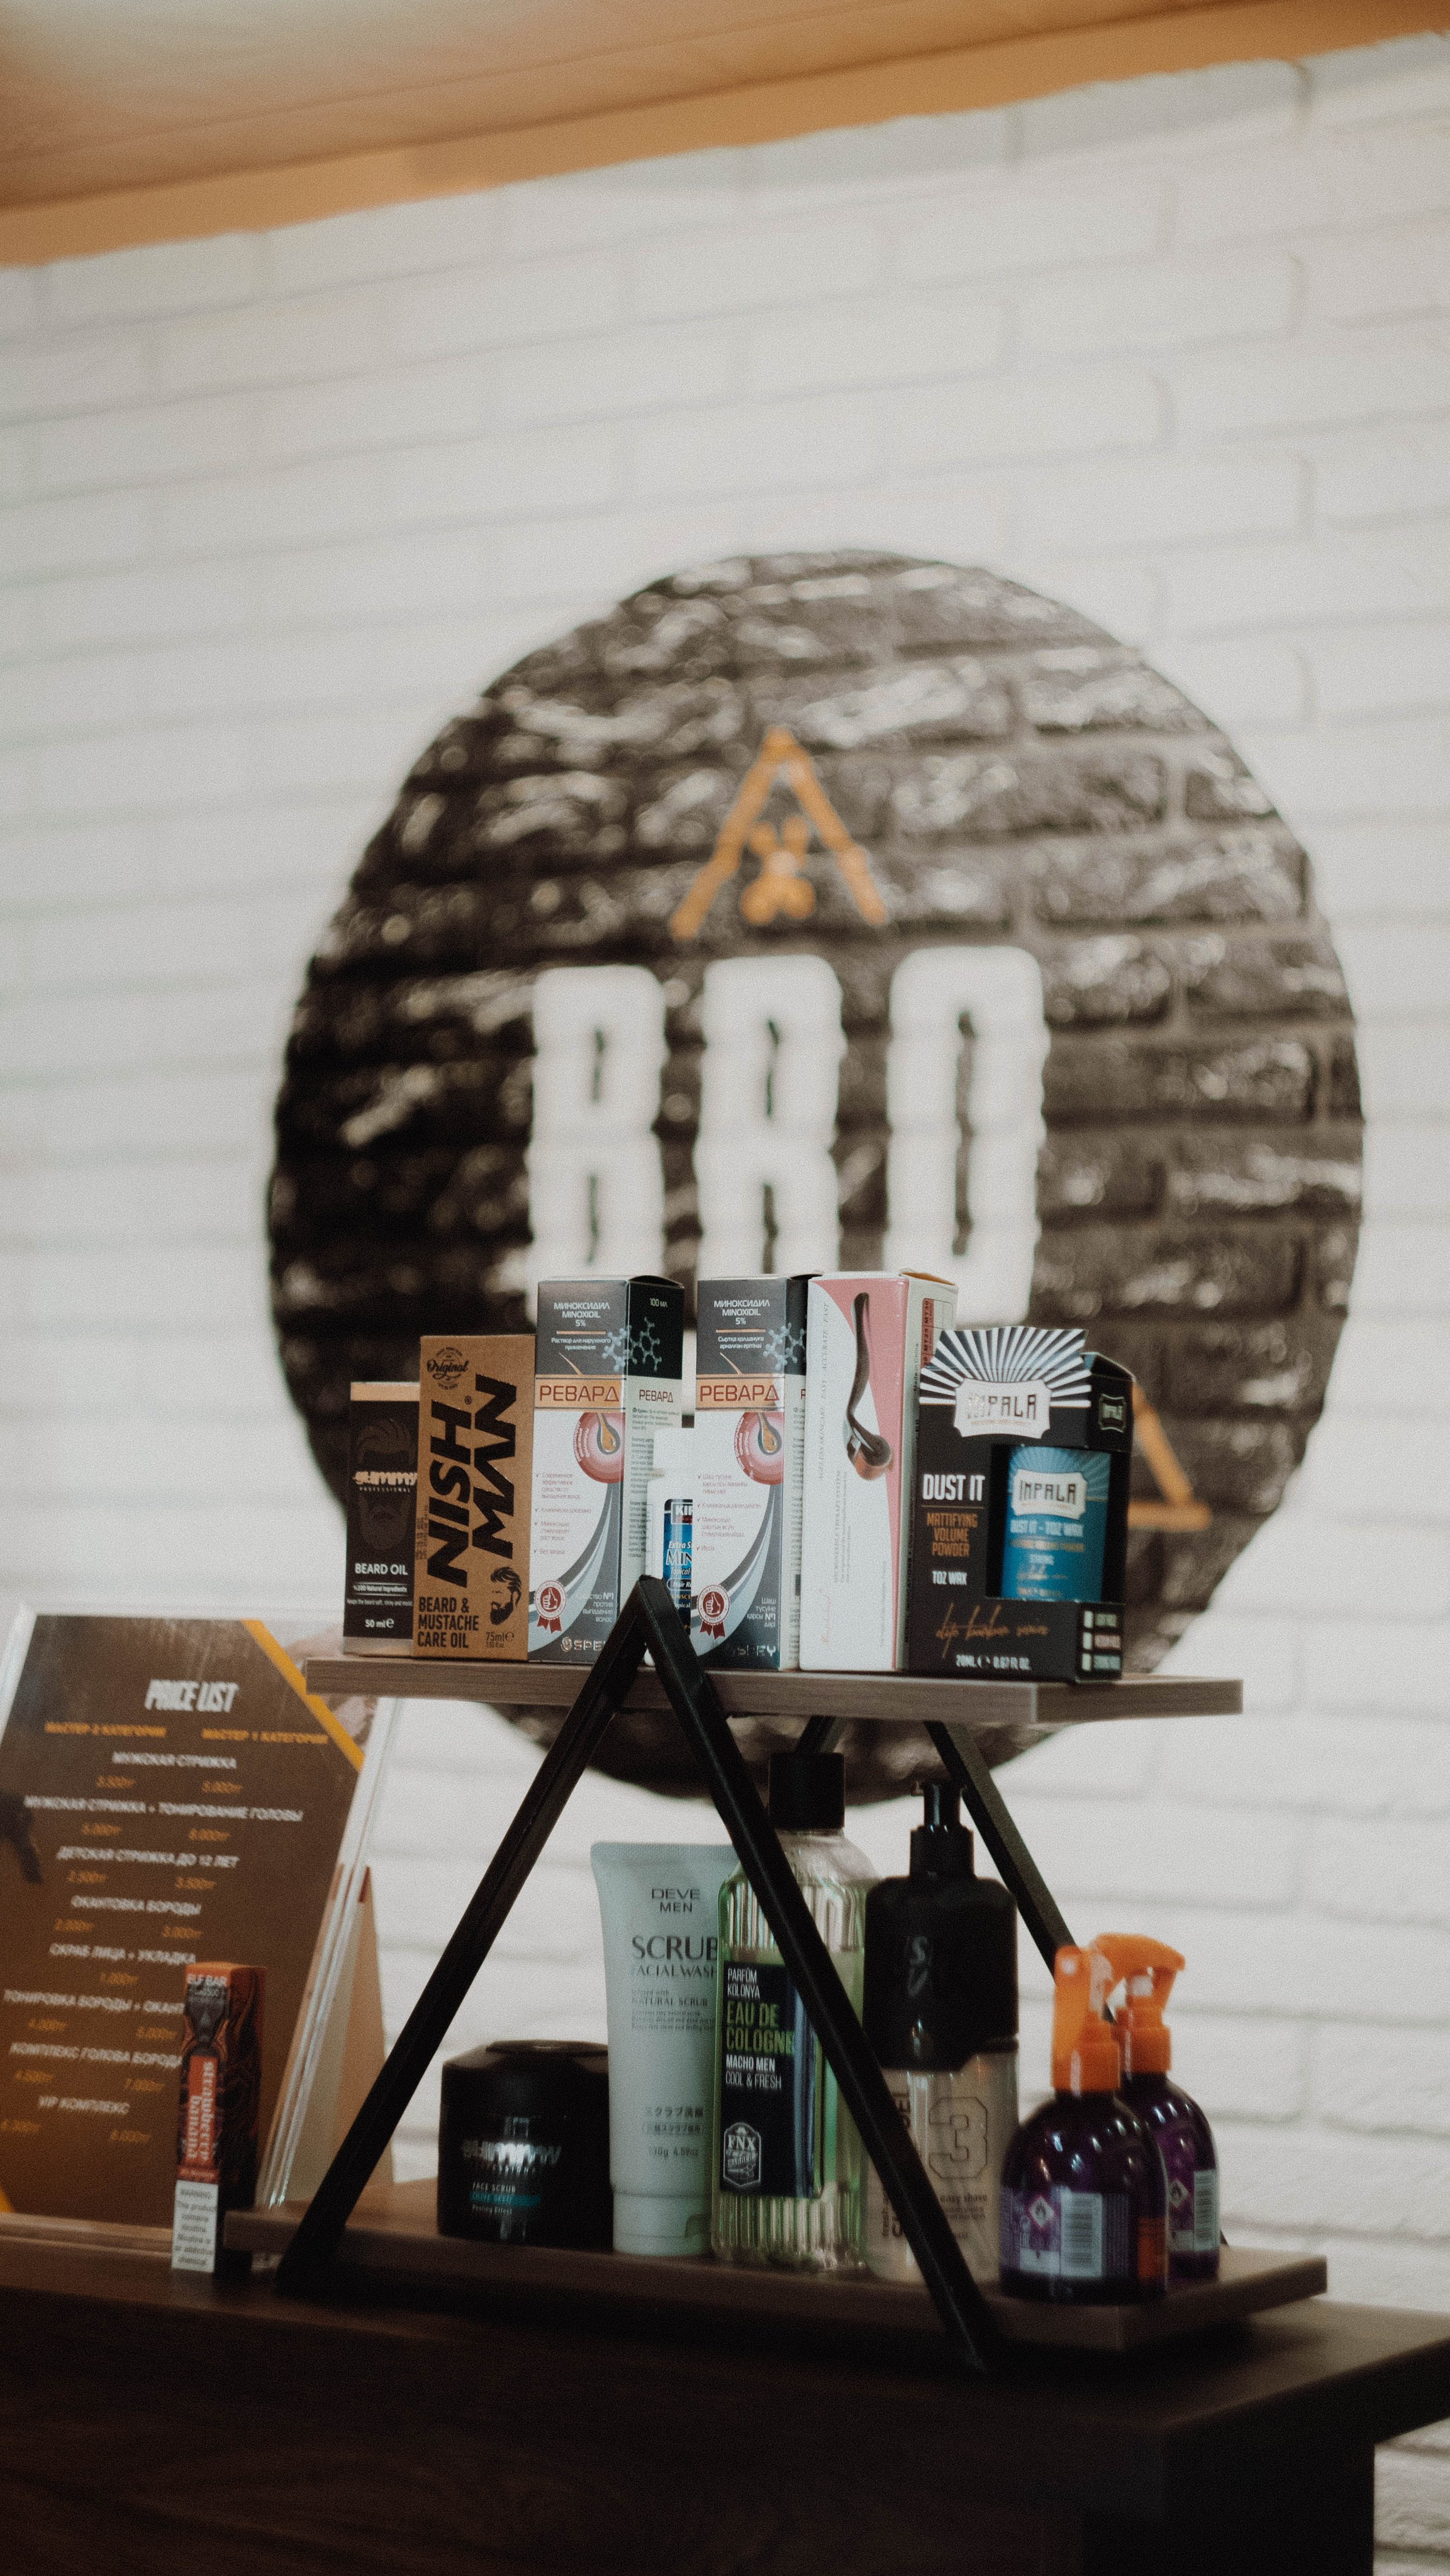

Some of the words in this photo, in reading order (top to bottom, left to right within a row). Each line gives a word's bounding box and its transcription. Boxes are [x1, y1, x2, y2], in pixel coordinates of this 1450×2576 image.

[525, 945, 1051, 1323] BRO
[650, 1298, 659, 1306] 100
[714, 1299, 771, 1307] МИНОКСИДИЛ
[562, 1311, 601, 1319] MINOXIDIL
[427, 1359, 469, 1380] Original
[540, 1385, 620, 1402] РЕВАРД
[639, 1389, 674, 1402] РЕВАРД
[700, 1385, 779, 1402] РЕВАРД
[472, 1373, 518, 1560] MAN
[427, 1399, 472, 1589] NISH
[923, 1474, 966, 1501] DUST
[969, 1475, 985, 1501] IT
[1018, 1480, 1076, 1505] IMPALA
[927, 1513, 978, 1528] MATTIFYING
[934, 1528, 969, 1543] VOLUME
[669, 1541, 686, 1549] Extra
[932, 1542, 970, 1558] POWDER
[354, 1562, 388, 1575] BEARD
[390, 1563, 408, 1576] OIL
[671, 1567, 690, 1575] Topical
[419, 1596, 457, 1613] BEARD
[461, 1597, 470, 1613] &
[365, 1619, 375, 1628] 50
[376, 1619, 385, 1628] ml
[418, 1614, 479, 1632] MUSTACHE
[417, 1631, 446, 1648] CARE
[450, 1633, 469, 1649] OIL
[574, 1639, 605, 1651] SPE
[145, 1679, 198, 1711] PRICE
[199, 1682, 240, 1713] LIST
[112, 1752, 176, 1767] МУЖСКАЯ
[176, 1754, 237, 1770] СТРИЖКА
[25, 1796, 86, 1811] МУЖСКАЯ
[87, 1798, 147, 1813] СТРИЖКА
[159, 1801, 249, 1819] ТОНИРОВАНИЕ
[250, 1807, 304, 1823] ГОЛОВЫ
[55, 1845, 114, 1861] ДЕТСКАЯ
[115, 1848, 175, 1863] СТРИЖКА
[214, 1855, 240, 1869] ЛЕТ
[652, 1888, 701, 1901] DEVE
[70, 1895, 145, 1912] ОКАНТОВКА
[146, 1899, 202, 1917] БОРОДЫ
[659, 1902, 693, 1913] MEN
[632, 1935, 718, 1960] SCRUB
[137, 1949, 196, 1966] УКЛАДКА
[187, 1973, 204, 1985] ELF
[205, 1975, 227, 1987] BAR
[727, 1967, 757, 1983] PARFÜM
[4, 1989, 76, 2006] ТОНИРОВКА
[77, 1996, 132, 2011] БОРОДЫ
[727, 1984, 761, 1999] KOLONYA
[727, 2001, 755, 2026] EAU
[759, 2003, 779, 2028] DE
[726, 2028, 793, 2055] COLOGNE
[9, 2041, 80, 2059] КОМПЛЕКС
[80, 2047, 130, 2062] ГОЛОВА
[726, 2055, 754, 2070] MACHO
[756, 2057, 776, 2072] MEN
[725, 2072, 744, 2086] COOL
[746, 2074, 753, 2088] &
[754, 2074, 782, 2089] FRESH
[38, 2095, 59, 2109] VIP
[59, 2097, 130, 2115] КОМПЛЕКС
[188, 2096, 203, 2158] banana
[728, 2135, 756, 2151] FNX
[929, 2097, 988, 2179] 3
[472, 2181, 489, 2191] FACE
[491, 2183, 516, 2194] SCRUB
[940, 2194, 961, 2205] easy
[964, 2192, 988, 2202] shave
